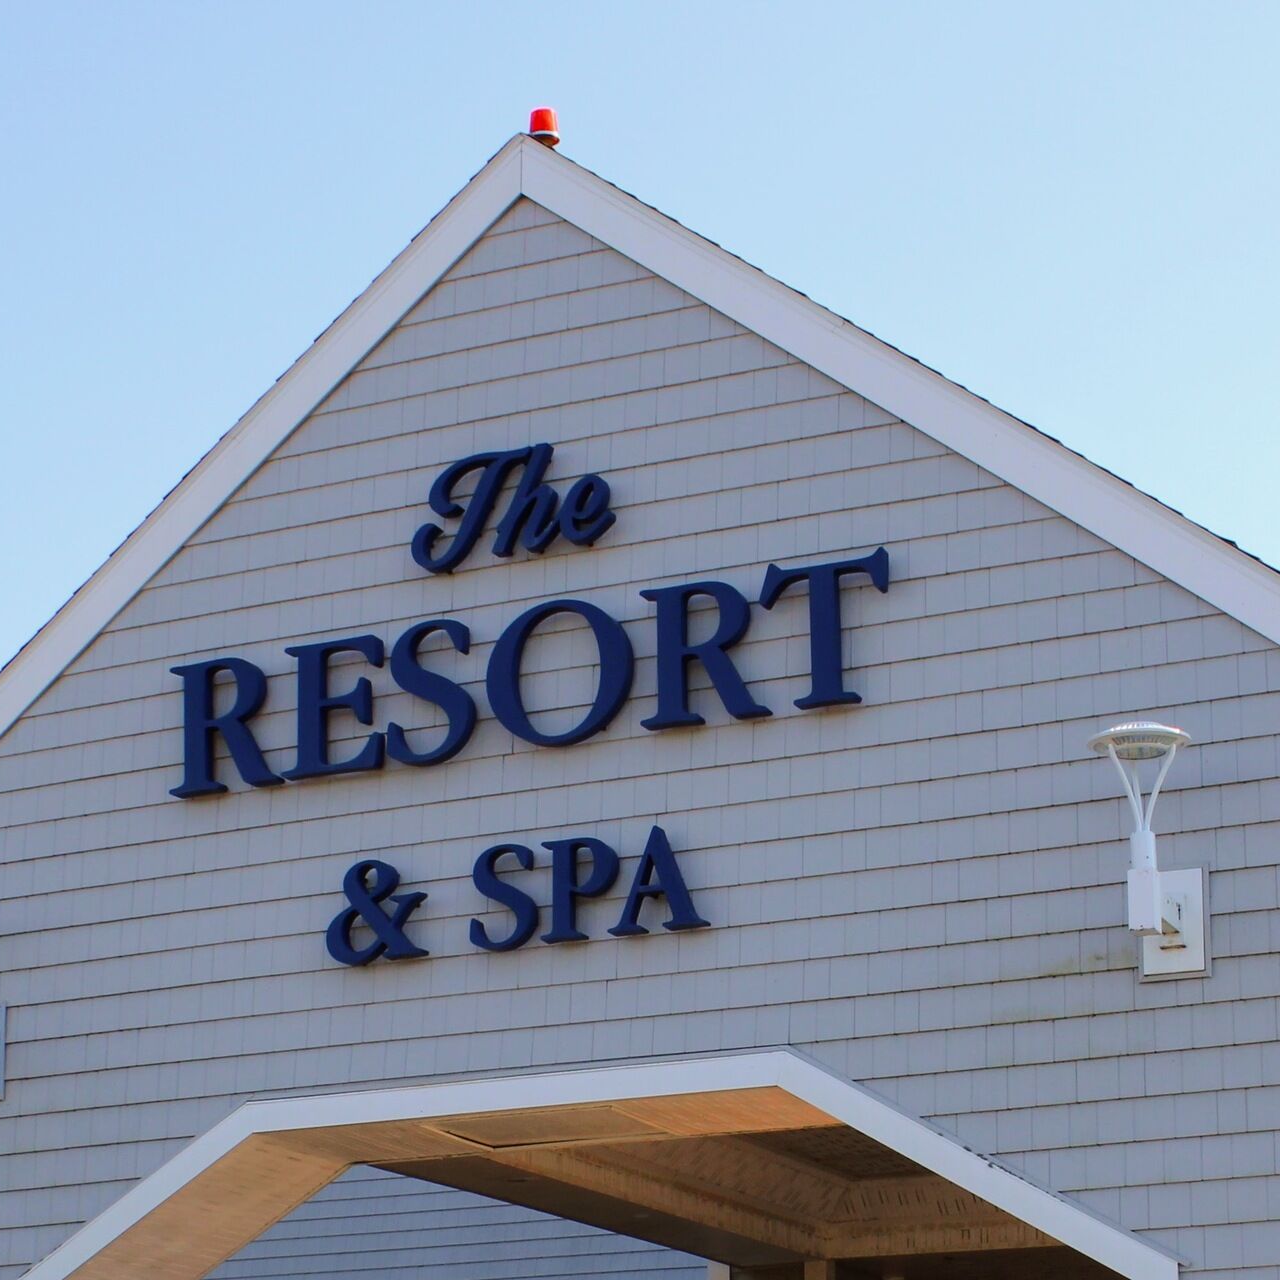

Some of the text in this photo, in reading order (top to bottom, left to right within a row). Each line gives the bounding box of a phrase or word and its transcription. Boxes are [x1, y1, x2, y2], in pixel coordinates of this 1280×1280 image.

[411, 443, 616, 575] The
[169, 546, 889, 799] RESORT
[326, 825, 712, 966] & SPA
